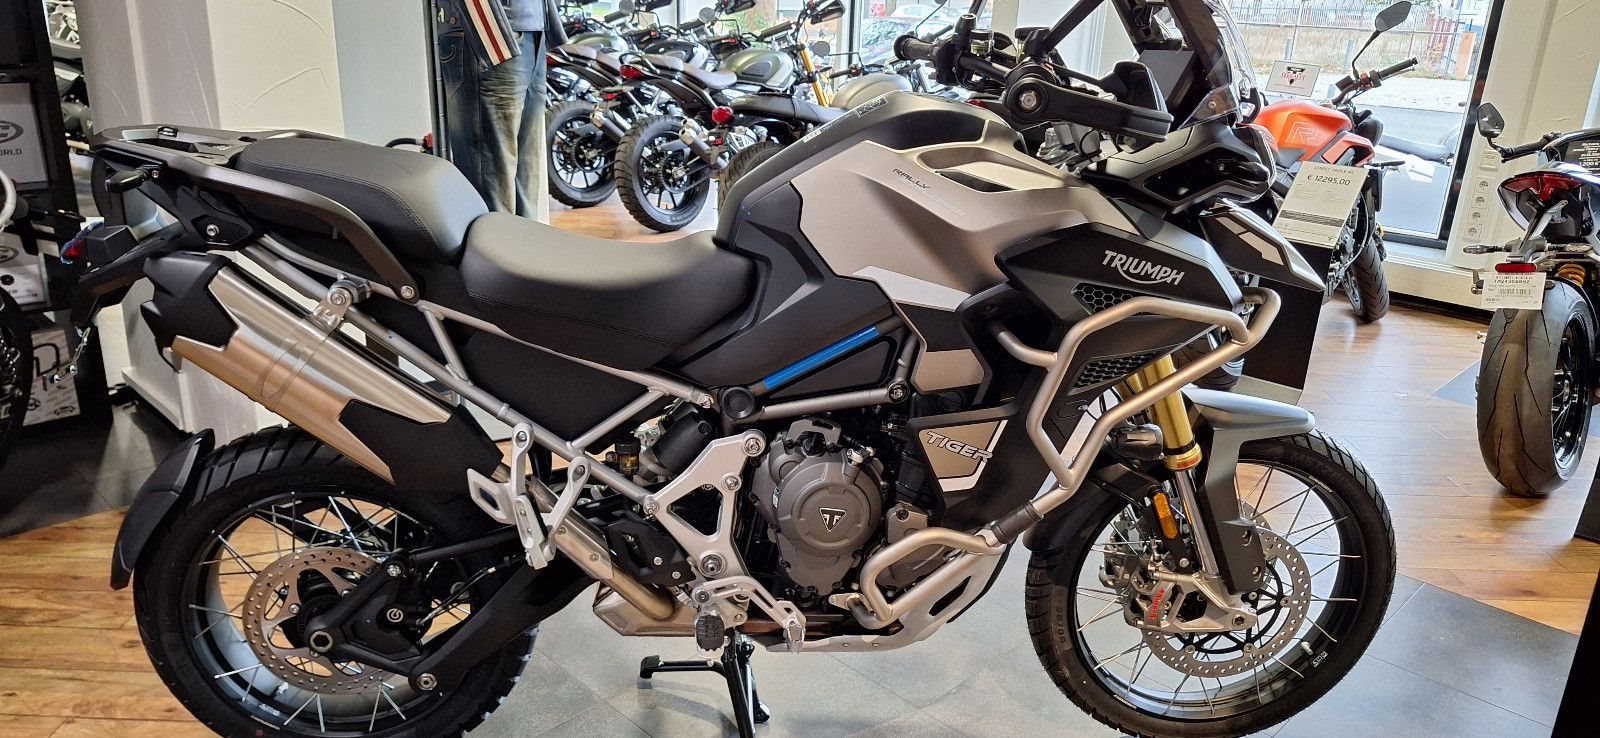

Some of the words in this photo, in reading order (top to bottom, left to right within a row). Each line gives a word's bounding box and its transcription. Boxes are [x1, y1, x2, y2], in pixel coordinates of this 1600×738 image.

[892, 168, 931, 188] RALLY
[1102, 250, 1185, 285] TRIUMPH
[927, 431, 993, 463] TIGER
